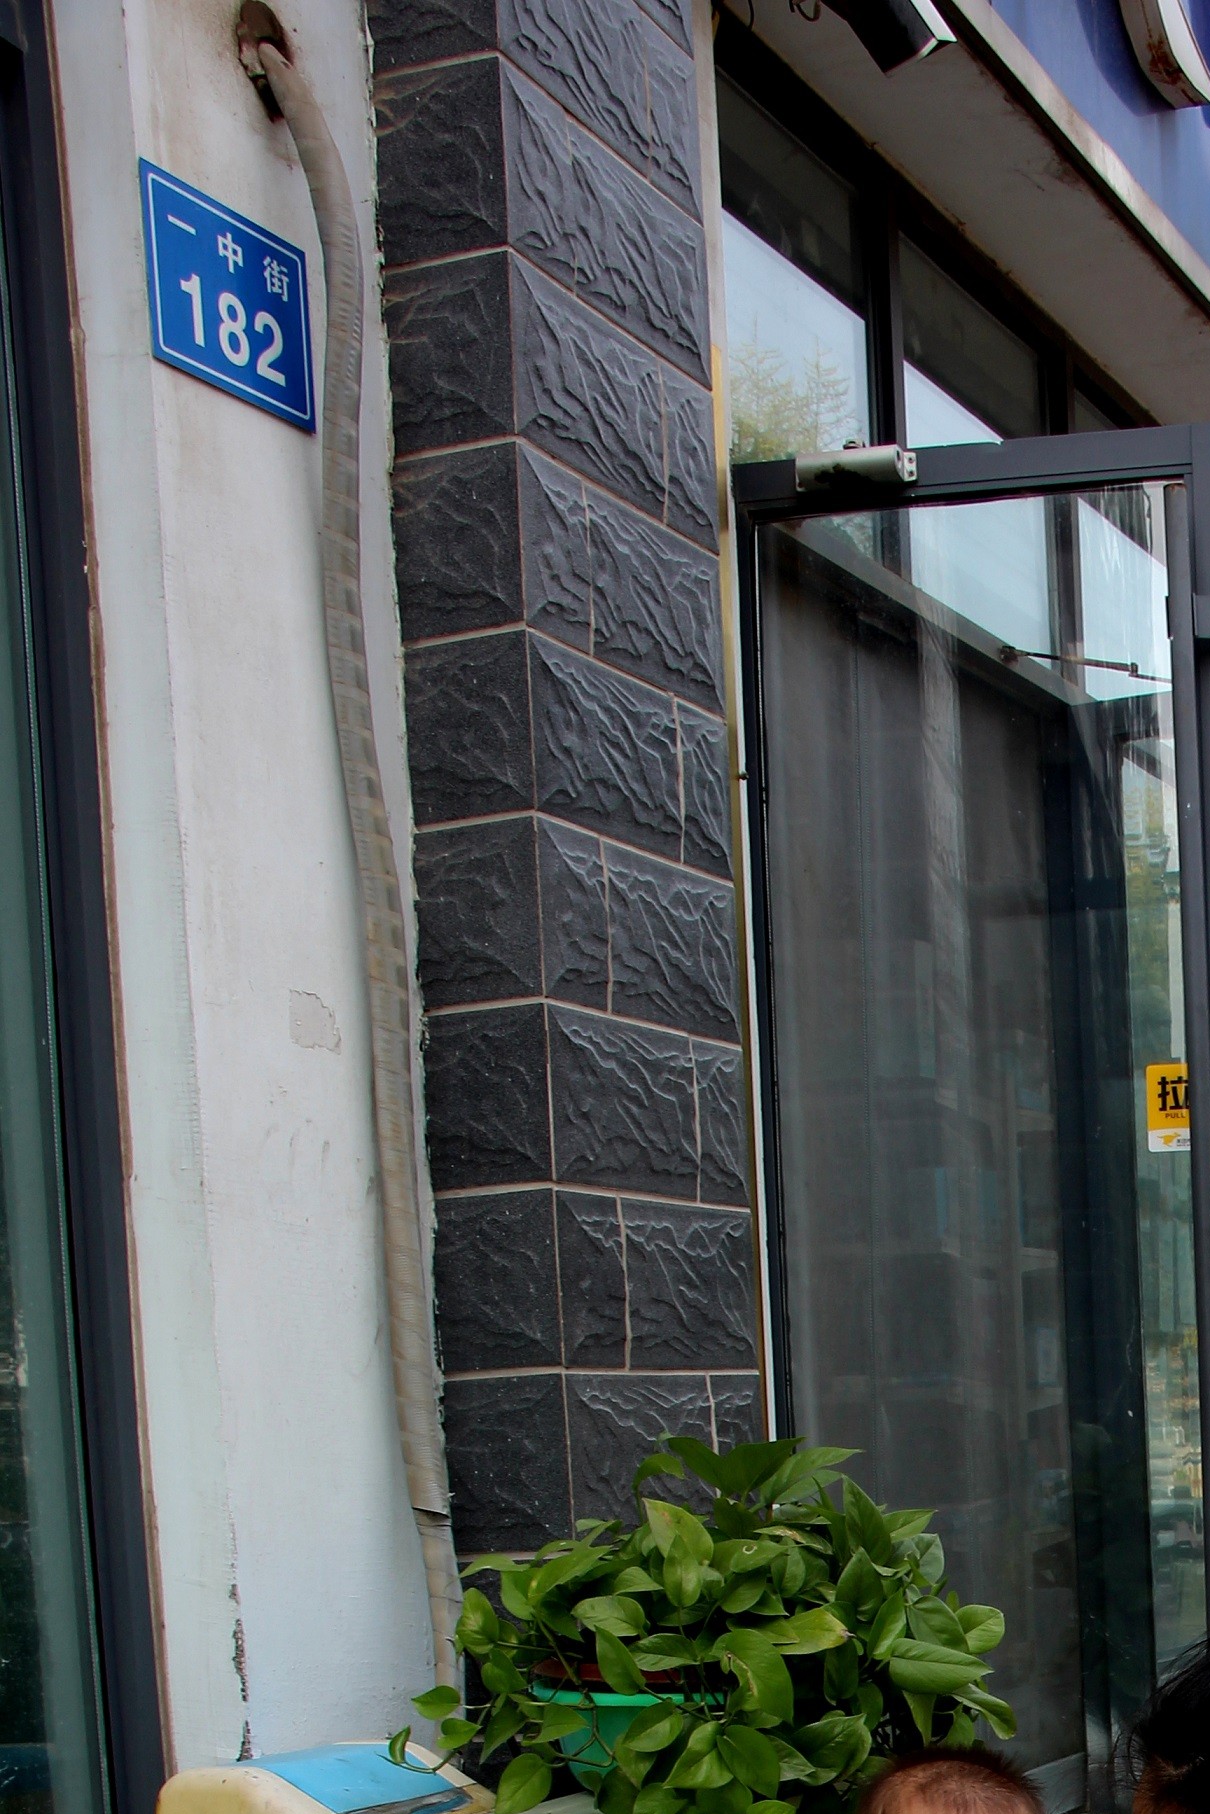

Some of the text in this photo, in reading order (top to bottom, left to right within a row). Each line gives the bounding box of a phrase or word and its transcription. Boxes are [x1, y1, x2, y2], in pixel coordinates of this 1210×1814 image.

[167, 214, 290, 303] 一中街
[180, 272, 287, 388] 182
[1157, 1076, 1190, 1112] 拉
